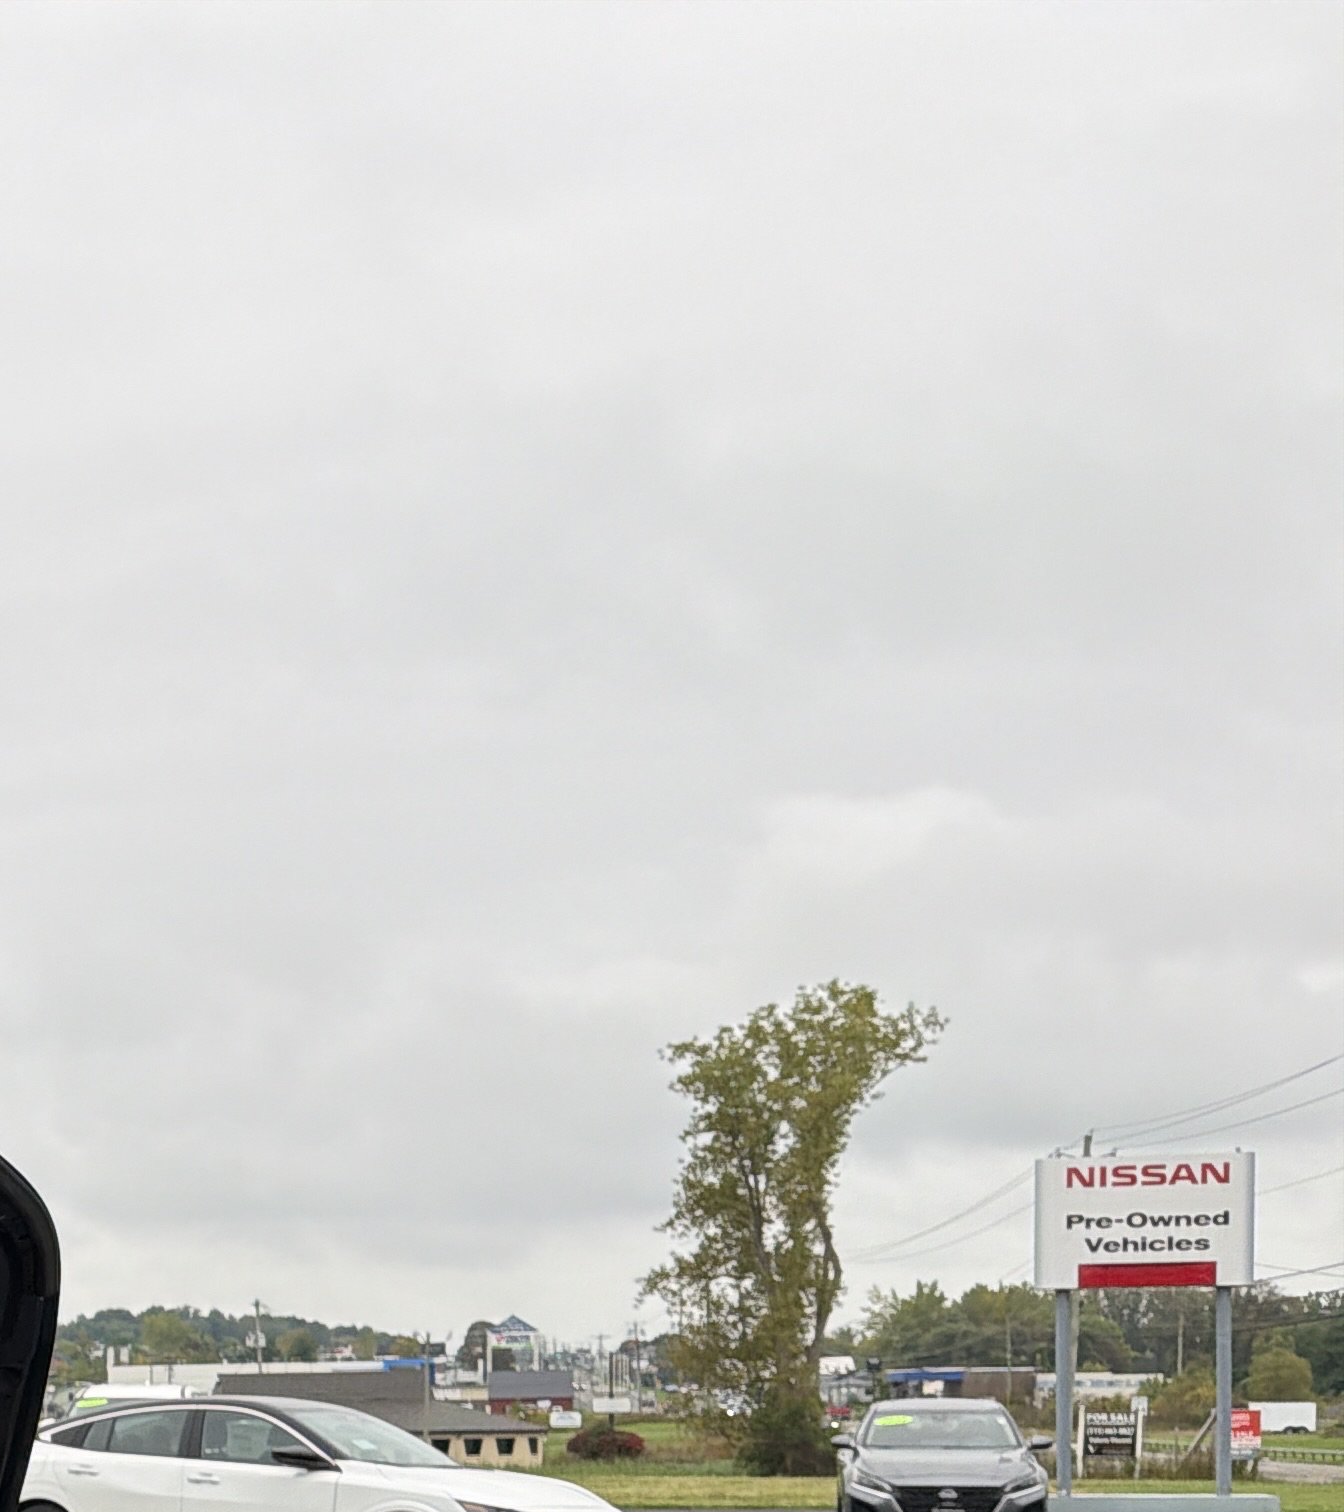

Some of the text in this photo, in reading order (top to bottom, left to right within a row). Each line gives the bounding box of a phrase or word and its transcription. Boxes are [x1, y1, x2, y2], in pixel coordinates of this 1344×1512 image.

[1066, 1162, 1230, 1188] NISSAN
[1066, 1210, 1230, 1230] Pre-Owned
[1085, 1236, 1211, 1253] Vehicles
